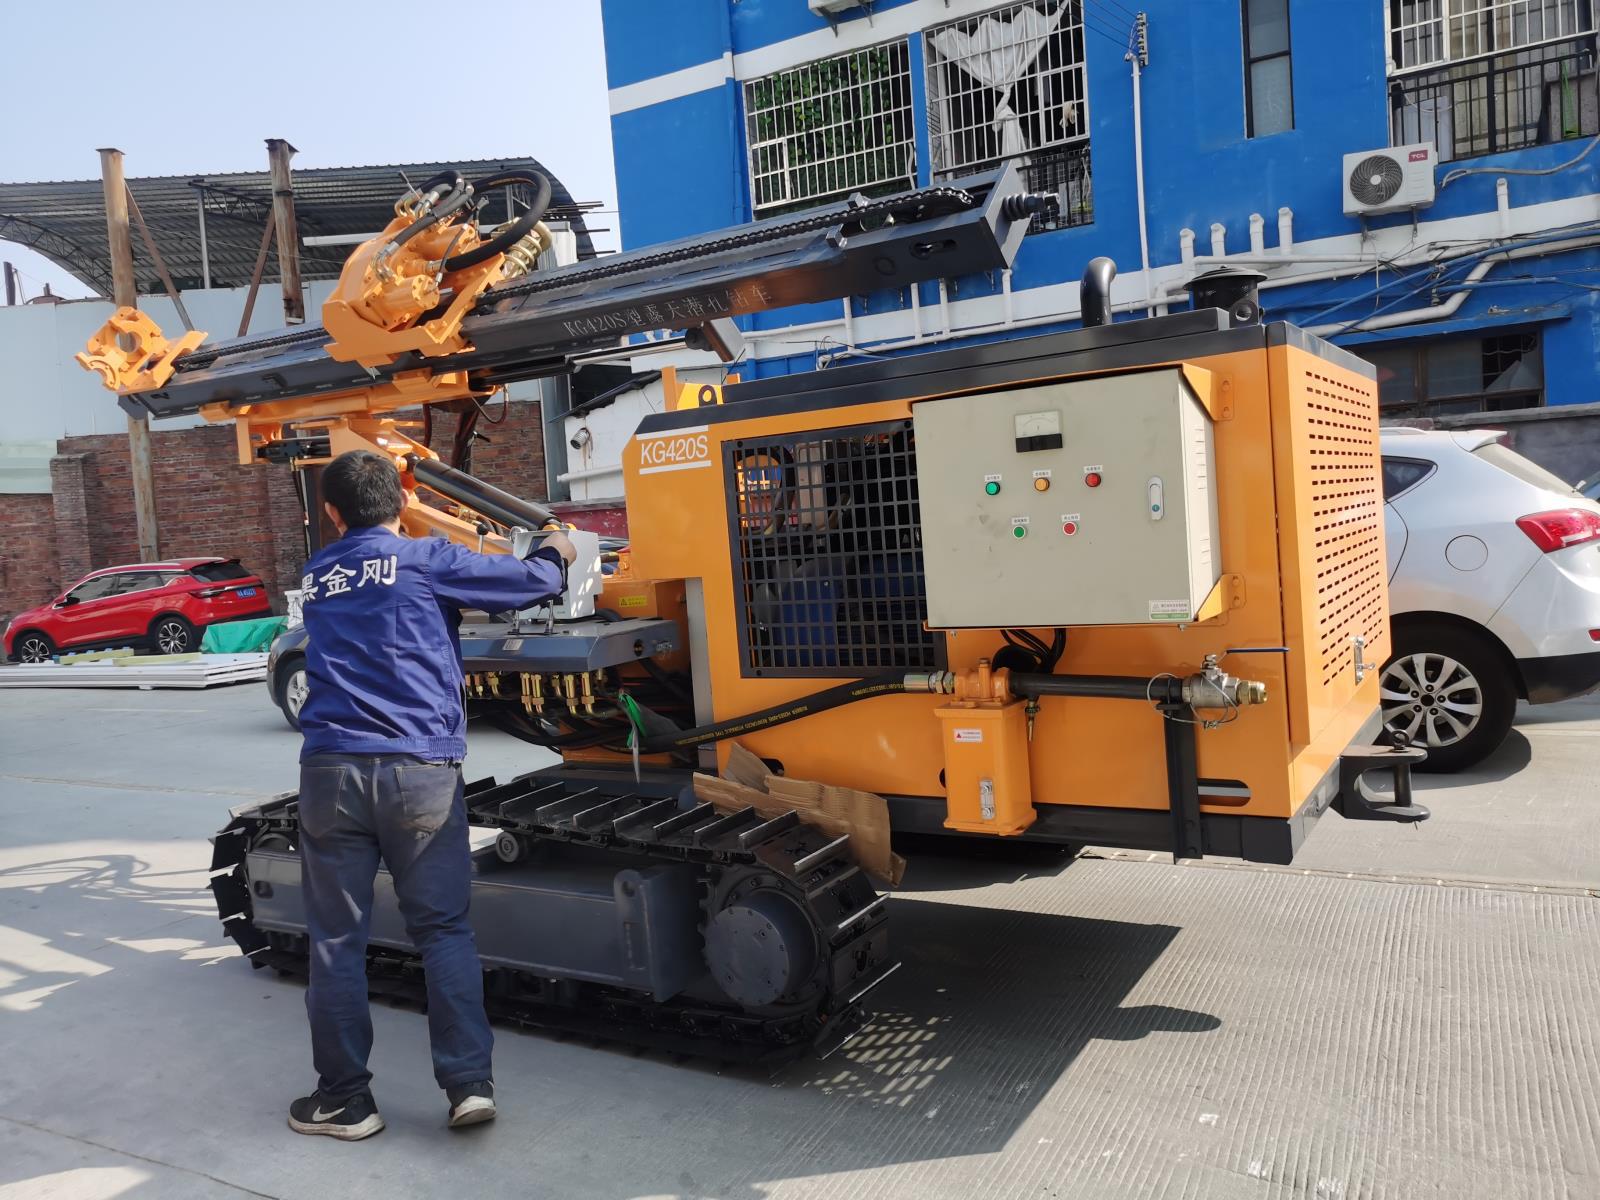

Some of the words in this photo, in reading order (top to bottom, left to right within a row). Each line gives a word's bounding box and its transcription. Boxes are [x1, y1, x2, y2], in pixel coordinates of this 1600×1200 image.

[641, 435, 708, 464] KG420S
[301, 555, 398, 601] 黑金刚
